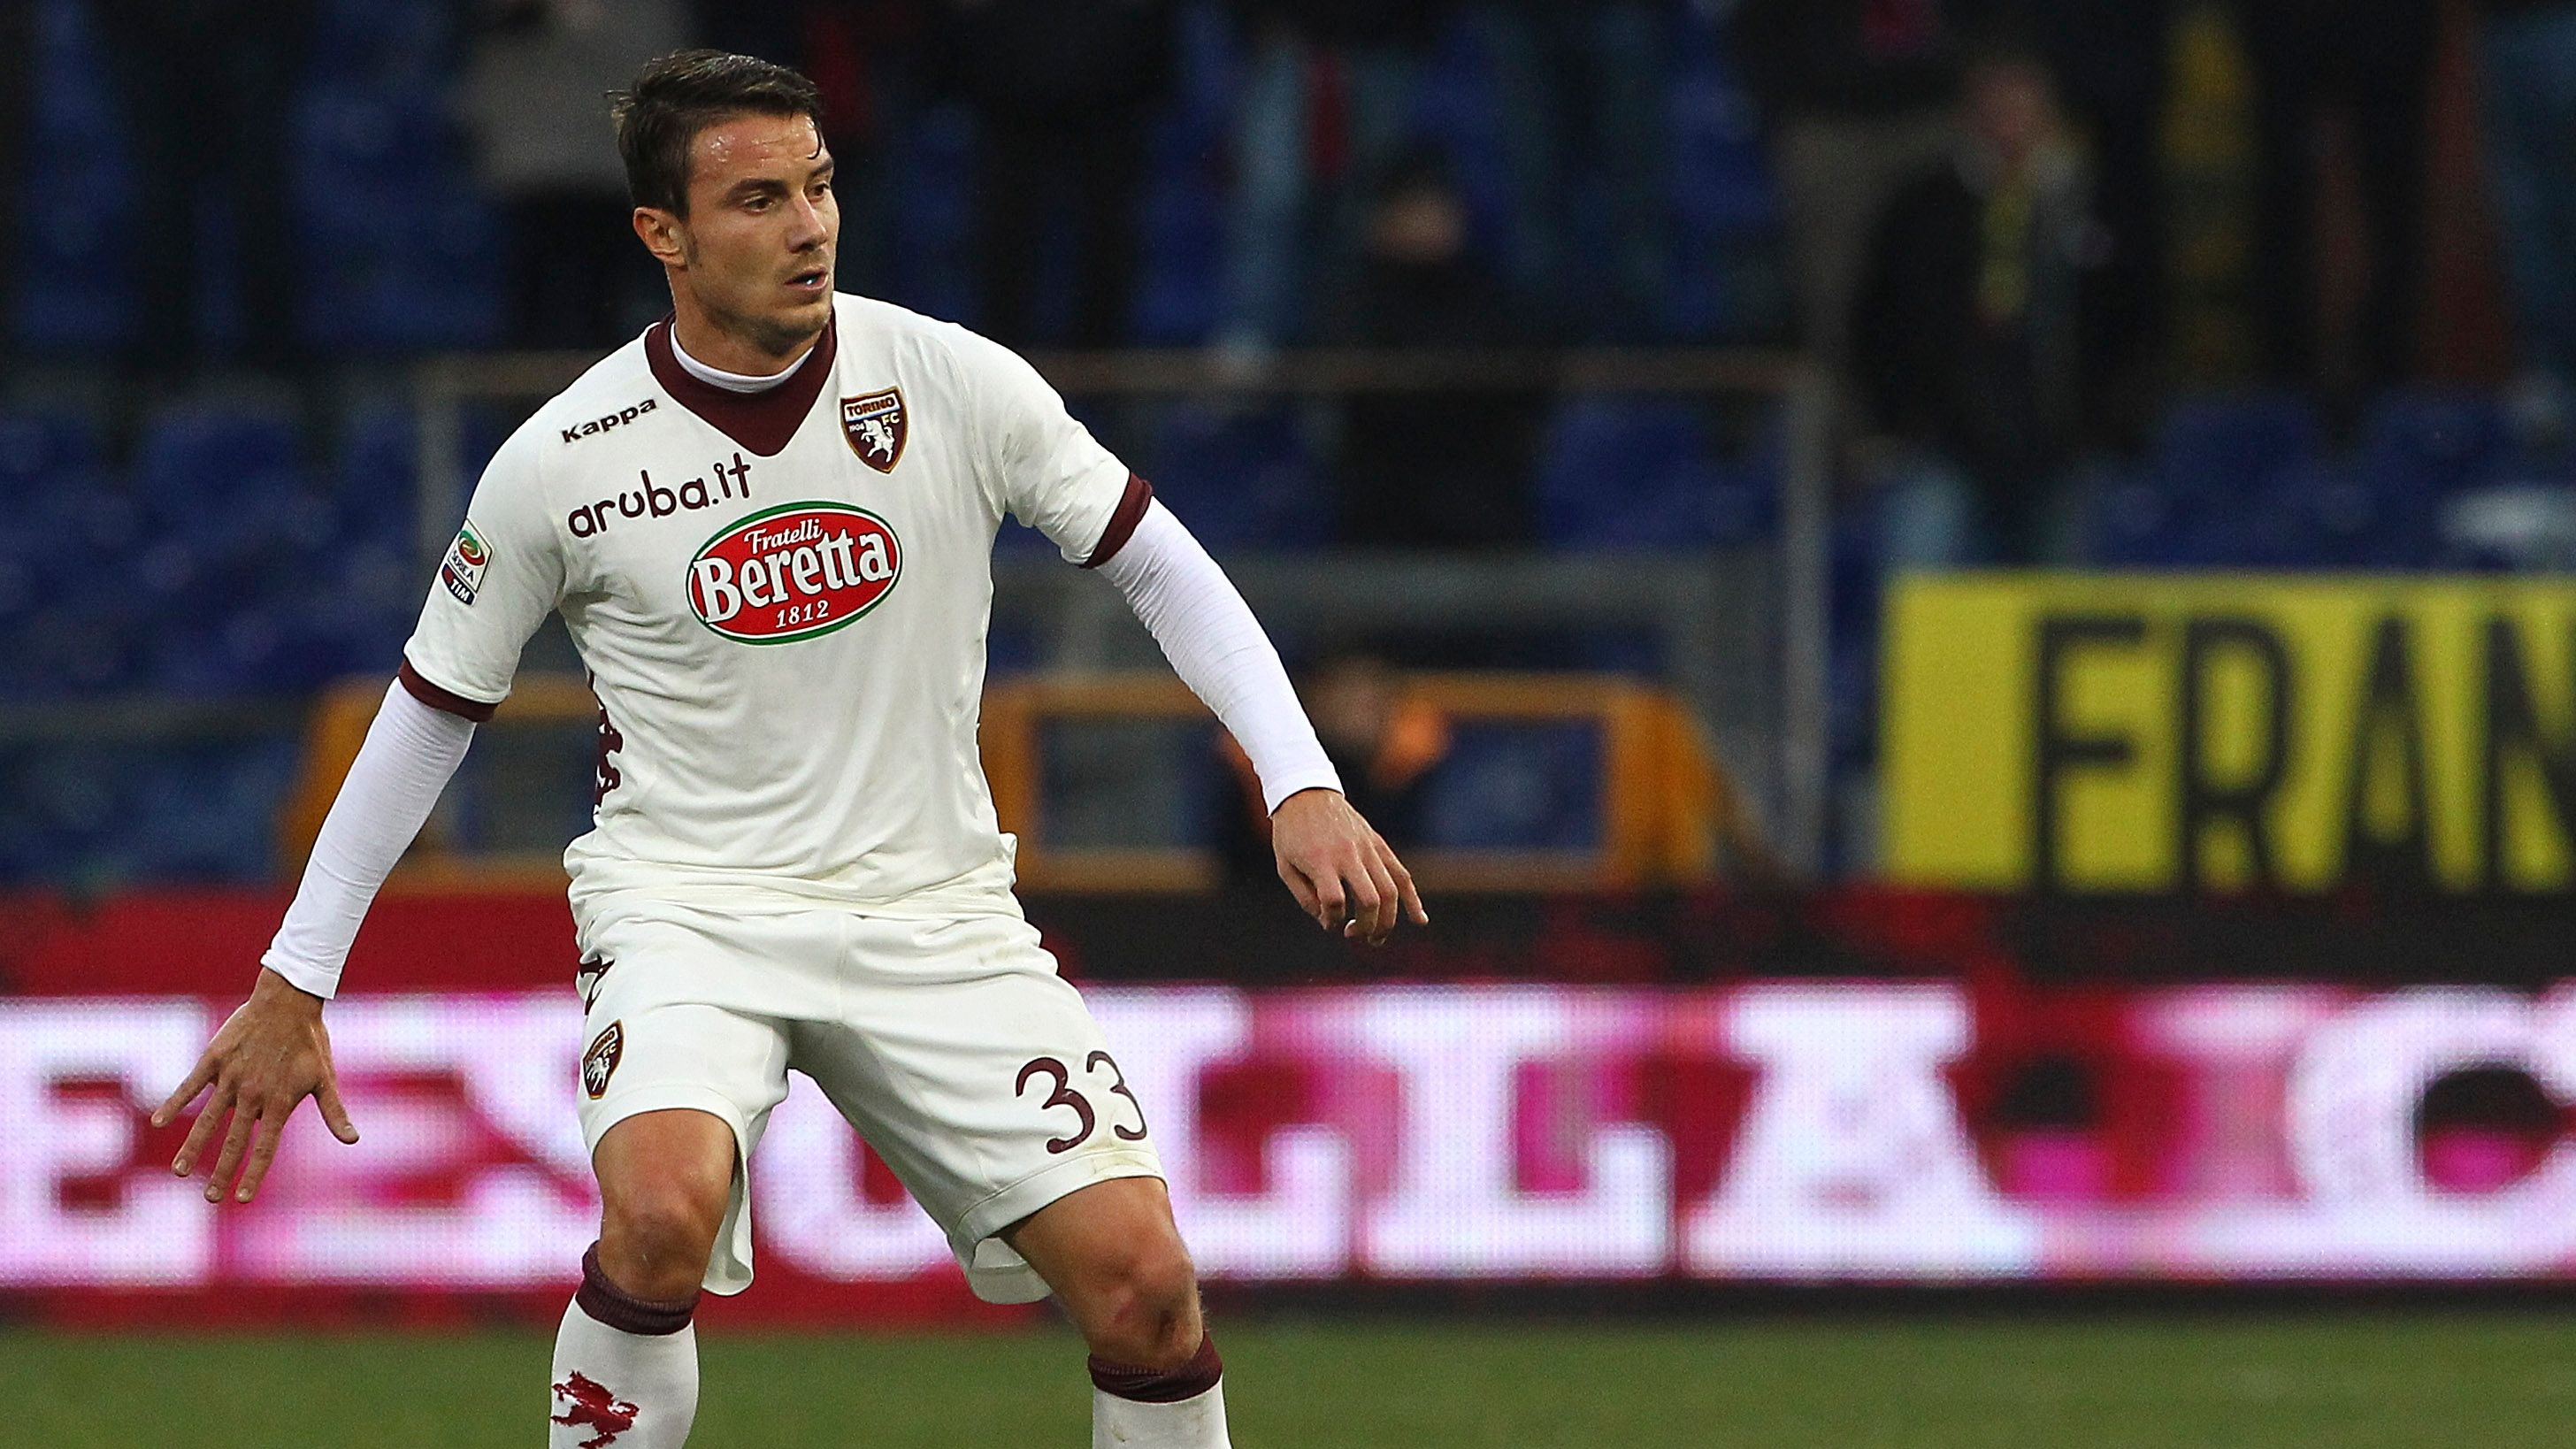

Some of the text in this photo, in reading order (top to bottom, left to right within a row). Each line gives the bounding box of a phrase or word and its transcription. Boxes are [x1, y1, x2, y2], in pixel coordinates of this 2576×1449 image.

[562, 399, 657, 443] Kappa
[847, 396, 895, 417] TORINO
[881, 412, 900, 426] FC
[568, 452, 751, 538] aruba.it
[744, 518, 822, 554] Fratelli
[450, 579, 471, 602] TIM
[694, 528, 893, 623] Beretta
[775, 600, 830, 628] 1812
[1016, 1050, 1147, 1154] 33
